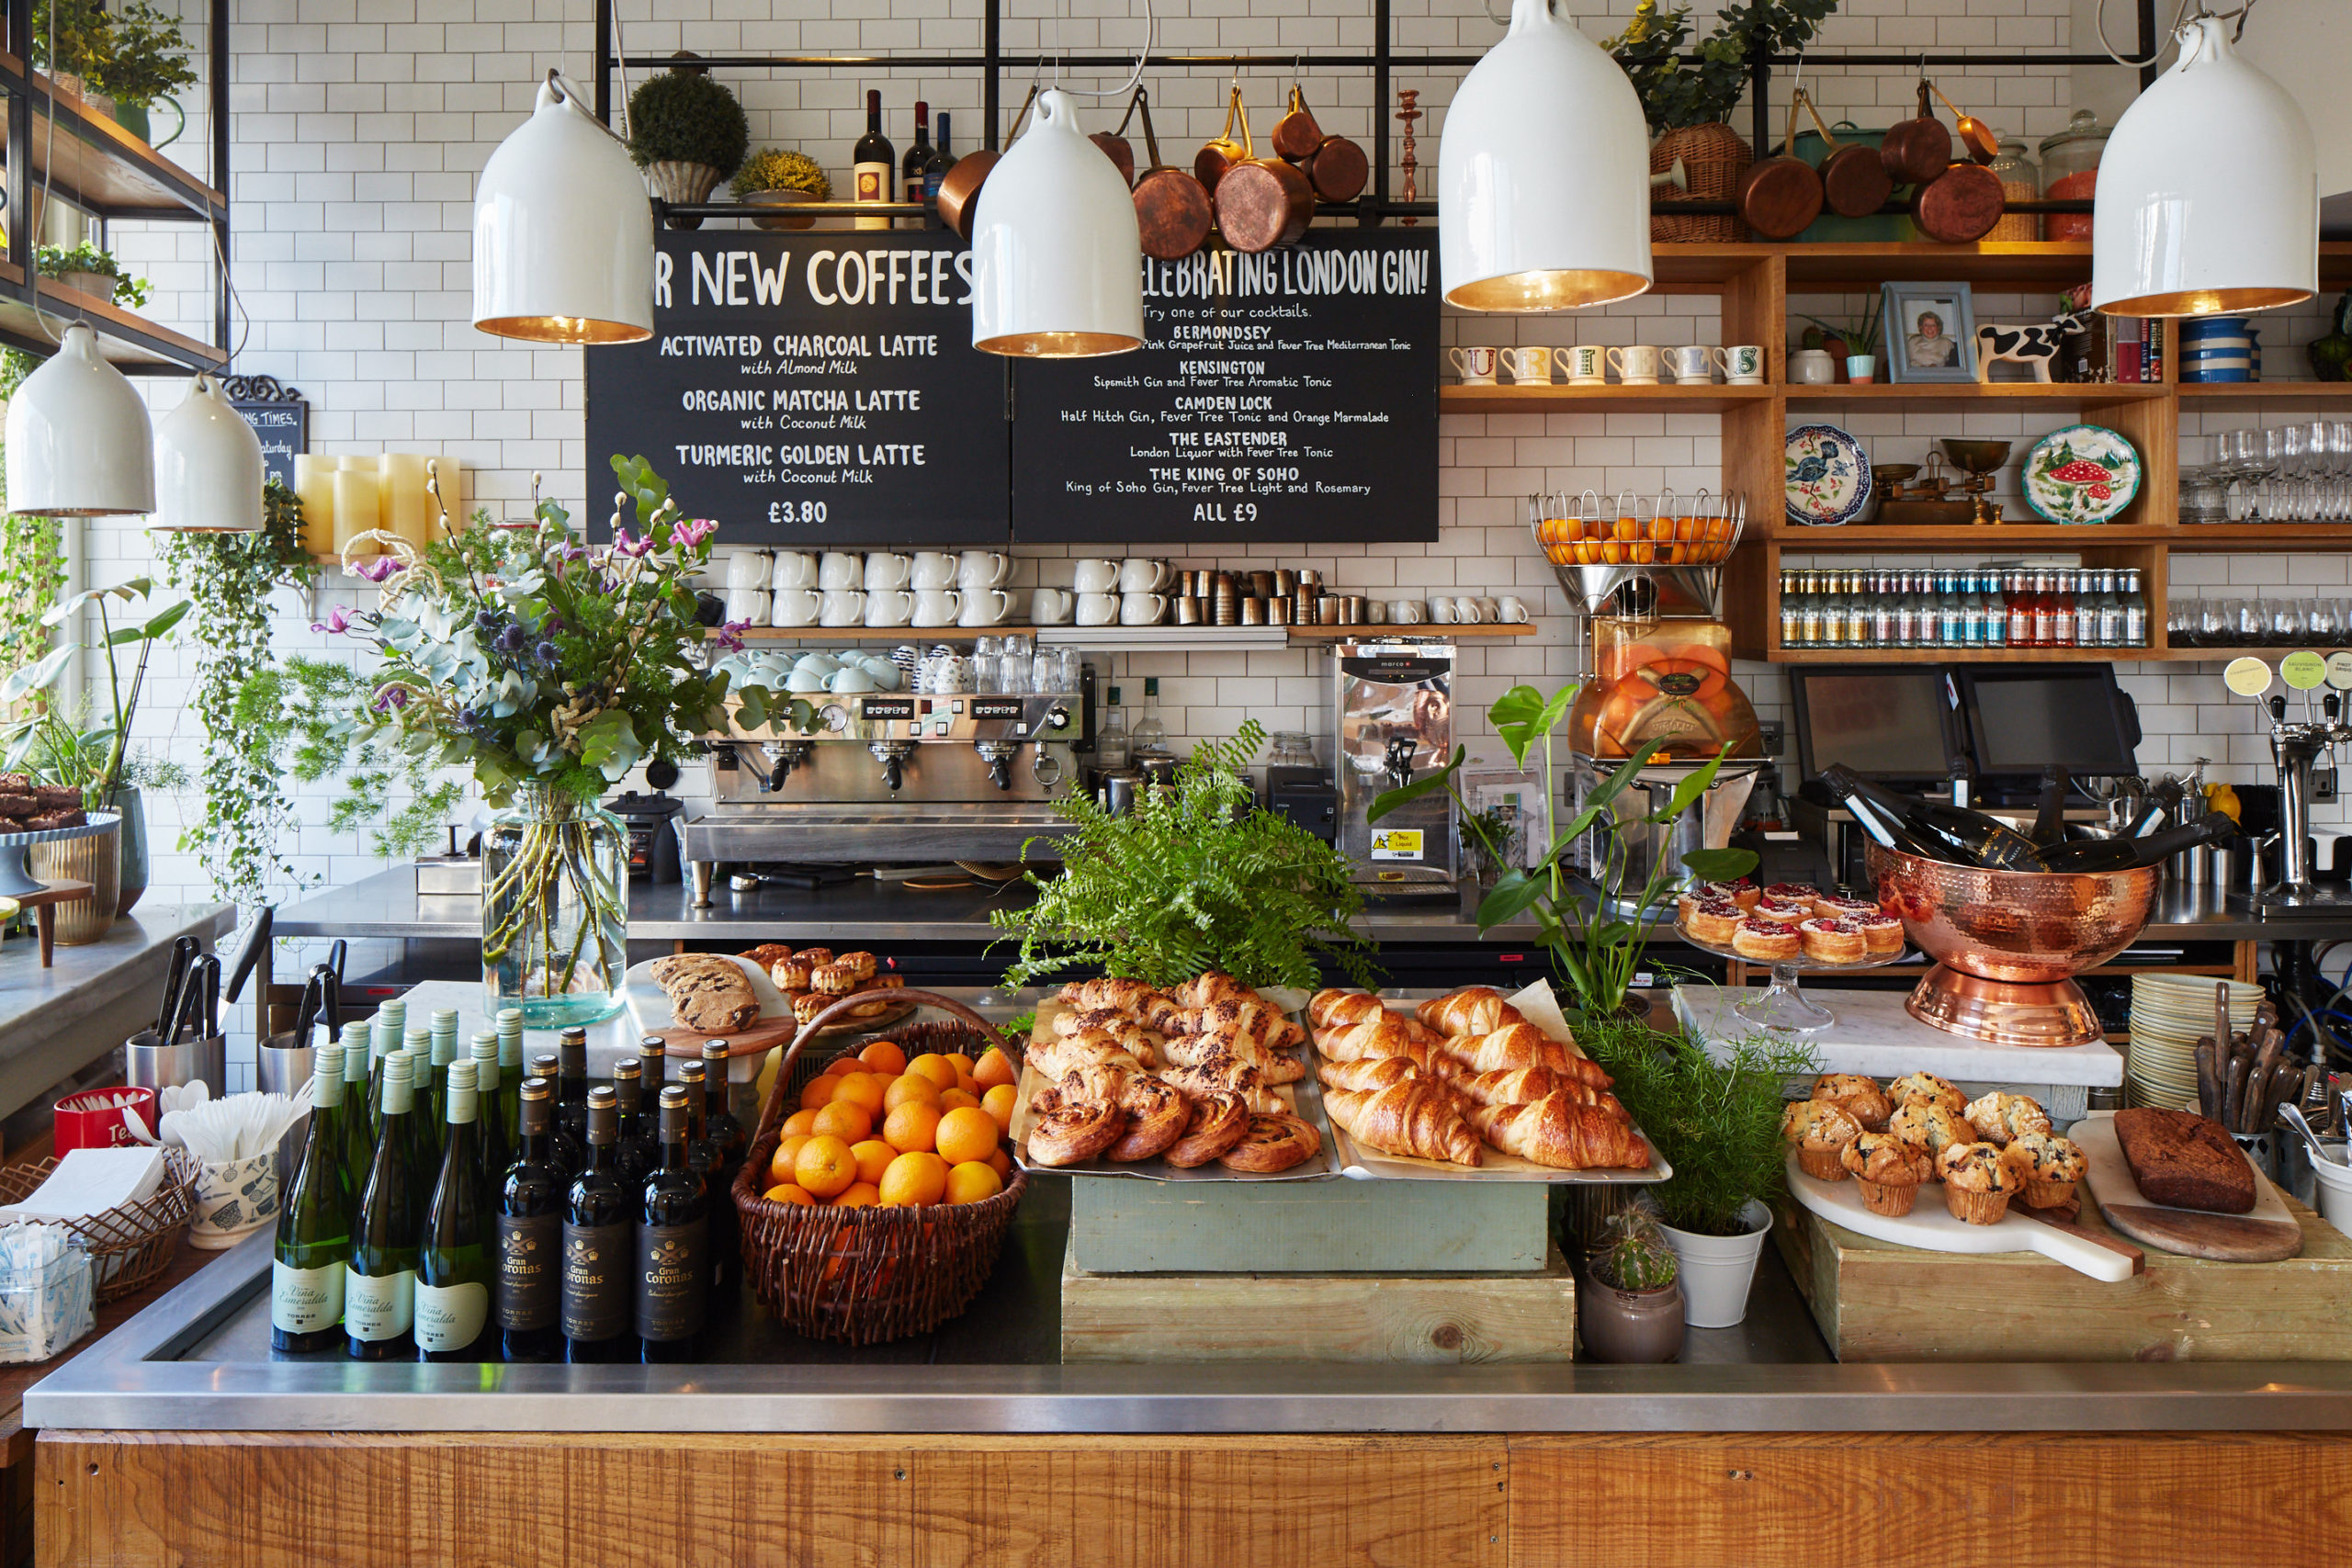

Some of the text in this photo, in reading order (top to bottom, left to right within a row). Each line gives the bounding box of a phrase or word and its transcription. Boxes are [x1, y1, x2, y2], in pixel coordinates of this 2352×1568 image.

[692, 251, 790, 306] NEW
[807, 250, 972, 305] COFFEES
[1283, 250, 1378, 296] LONDON
[1382, 250, 1430, 296] GIN!
[1143, 303, 1312, 321] Try one of our cocktails.
[1173, 325, 1272, 340] BERMONDSEY
[661, 335, 938, 357] ACTIVATED CHARCOAL LATTE
[1142, 339, 1411, 353] Pink Grapefruit Juice and Fever Tree Mediterranean Tonic
[741, 359, 857, 375] with Almond Milk
[1180, 360, 1265, 375] KENSINGTON
[1735, 347, 1758, 376] S
[1093, 376, 1332, 389] Sipsmith Gin and Fever Tree Aromatic Tonic
[683, 390, 921, 412] ORGANIC MATCHA LATTE
[1175, 396, 1272, 411] CAMDEN LOCK
[741, 414, 866, 430] with Coconut Milk
[1061, 411, 1389, 425] Half Hitch Gin, Fever Tree Tonic and Orange Marmalade
[1170, 432, 1287, 446] THE EASTENDER
[261, 439, 291, 461] aturday
[675, 445, 925, 467] TURMERIC GOLDEN LATTE
[1130, 446, 1333, 461] London Liquor with Fever Tree Tonic
[743, 469, 873, 484] with Coconut Milk
[1149, 468, 1299, 481] THE KING OF SOHO
[1067, 481, 1371, 496] King of Soho Gin, Fever Tree Light and Rosemary
[768, 501, 828, 524] £3.80
[1193, 503, 1258, 523] ALL £9
[507, 1256, 526, 1266] Gran
[501, 1264, 542, 1275] oronas
[571, 1265, 588, 1275] Gran
[646, 1270, 693, 1284] Coronas
[659, 1267, 680, 1276] Gran
[566, 1271, 604, 1285] oronas
[289, 1284, 315, 1296] Viña
[279, 1291, 328, 1305] Esmeralda
